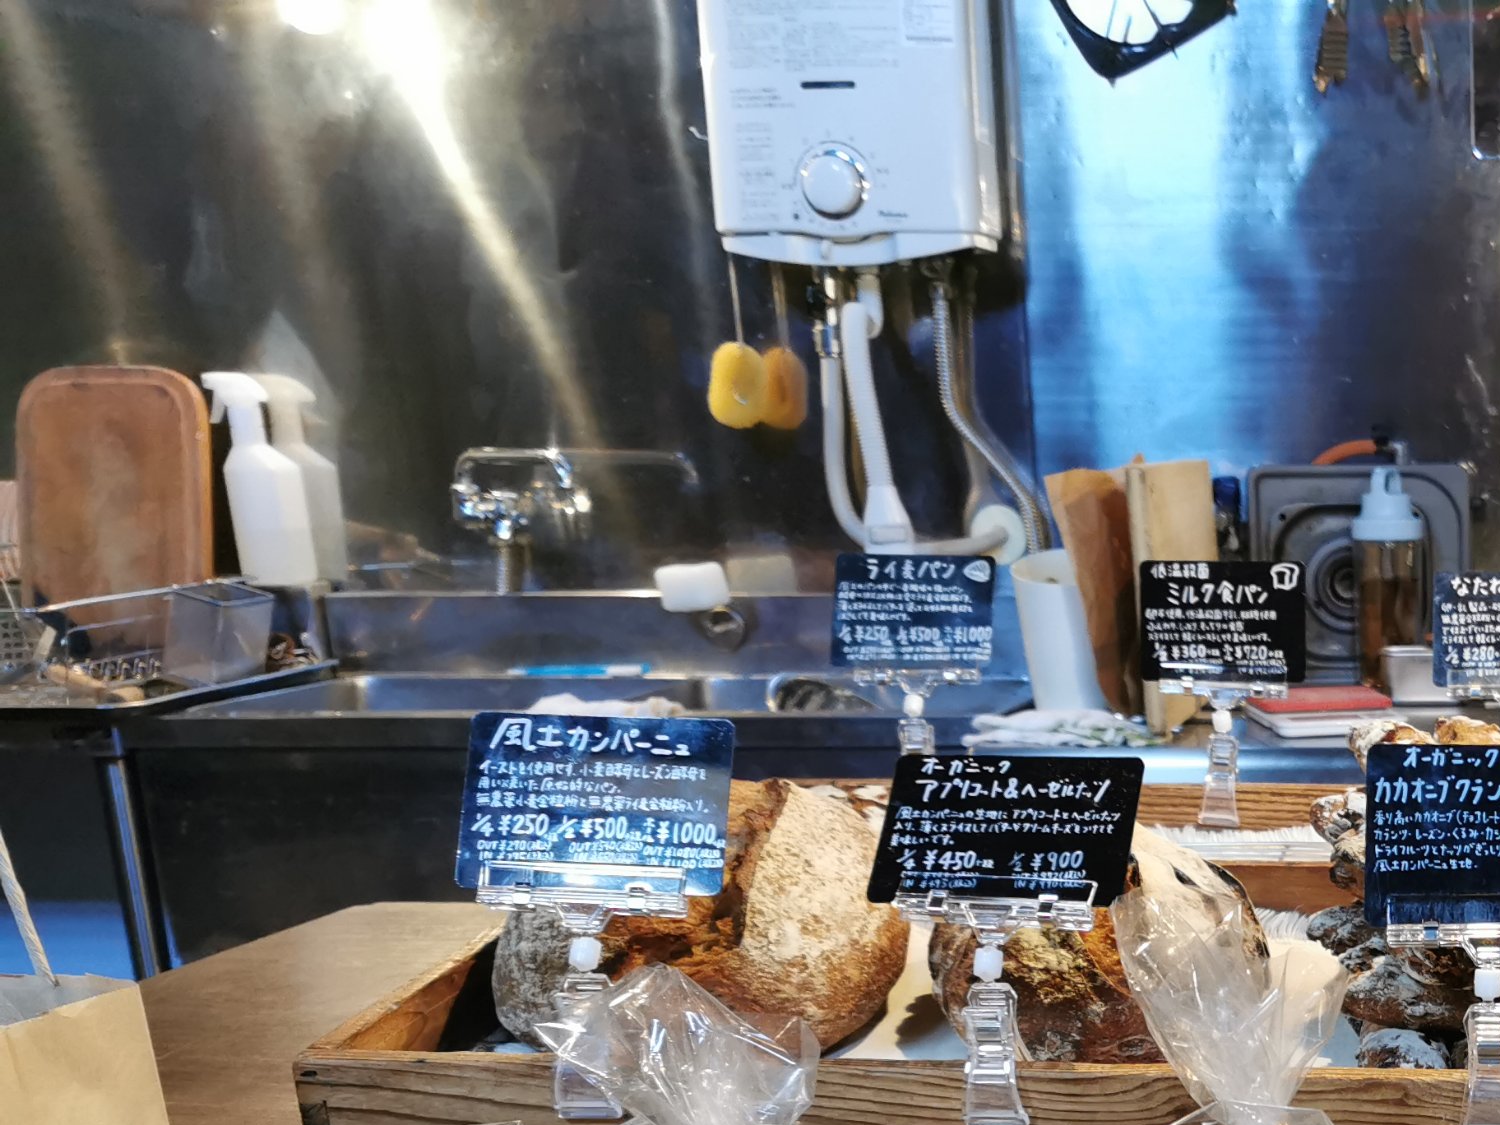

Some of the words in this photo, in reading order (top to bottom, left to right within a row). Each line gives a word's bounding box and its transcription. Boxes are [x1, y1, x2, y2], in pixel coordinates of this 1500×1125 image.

[866, 559, 955, 579] ライ麦パン
[1167, 580, 1268, 605] ミルク食パン
[489, 717, 691, 757] 風土カンパーニュ
[920, 757, 1011, 776] オーガニック
[1402, 746, 1499, 768] オーガニック
[1030, 850, 1084, 870] ¥900
